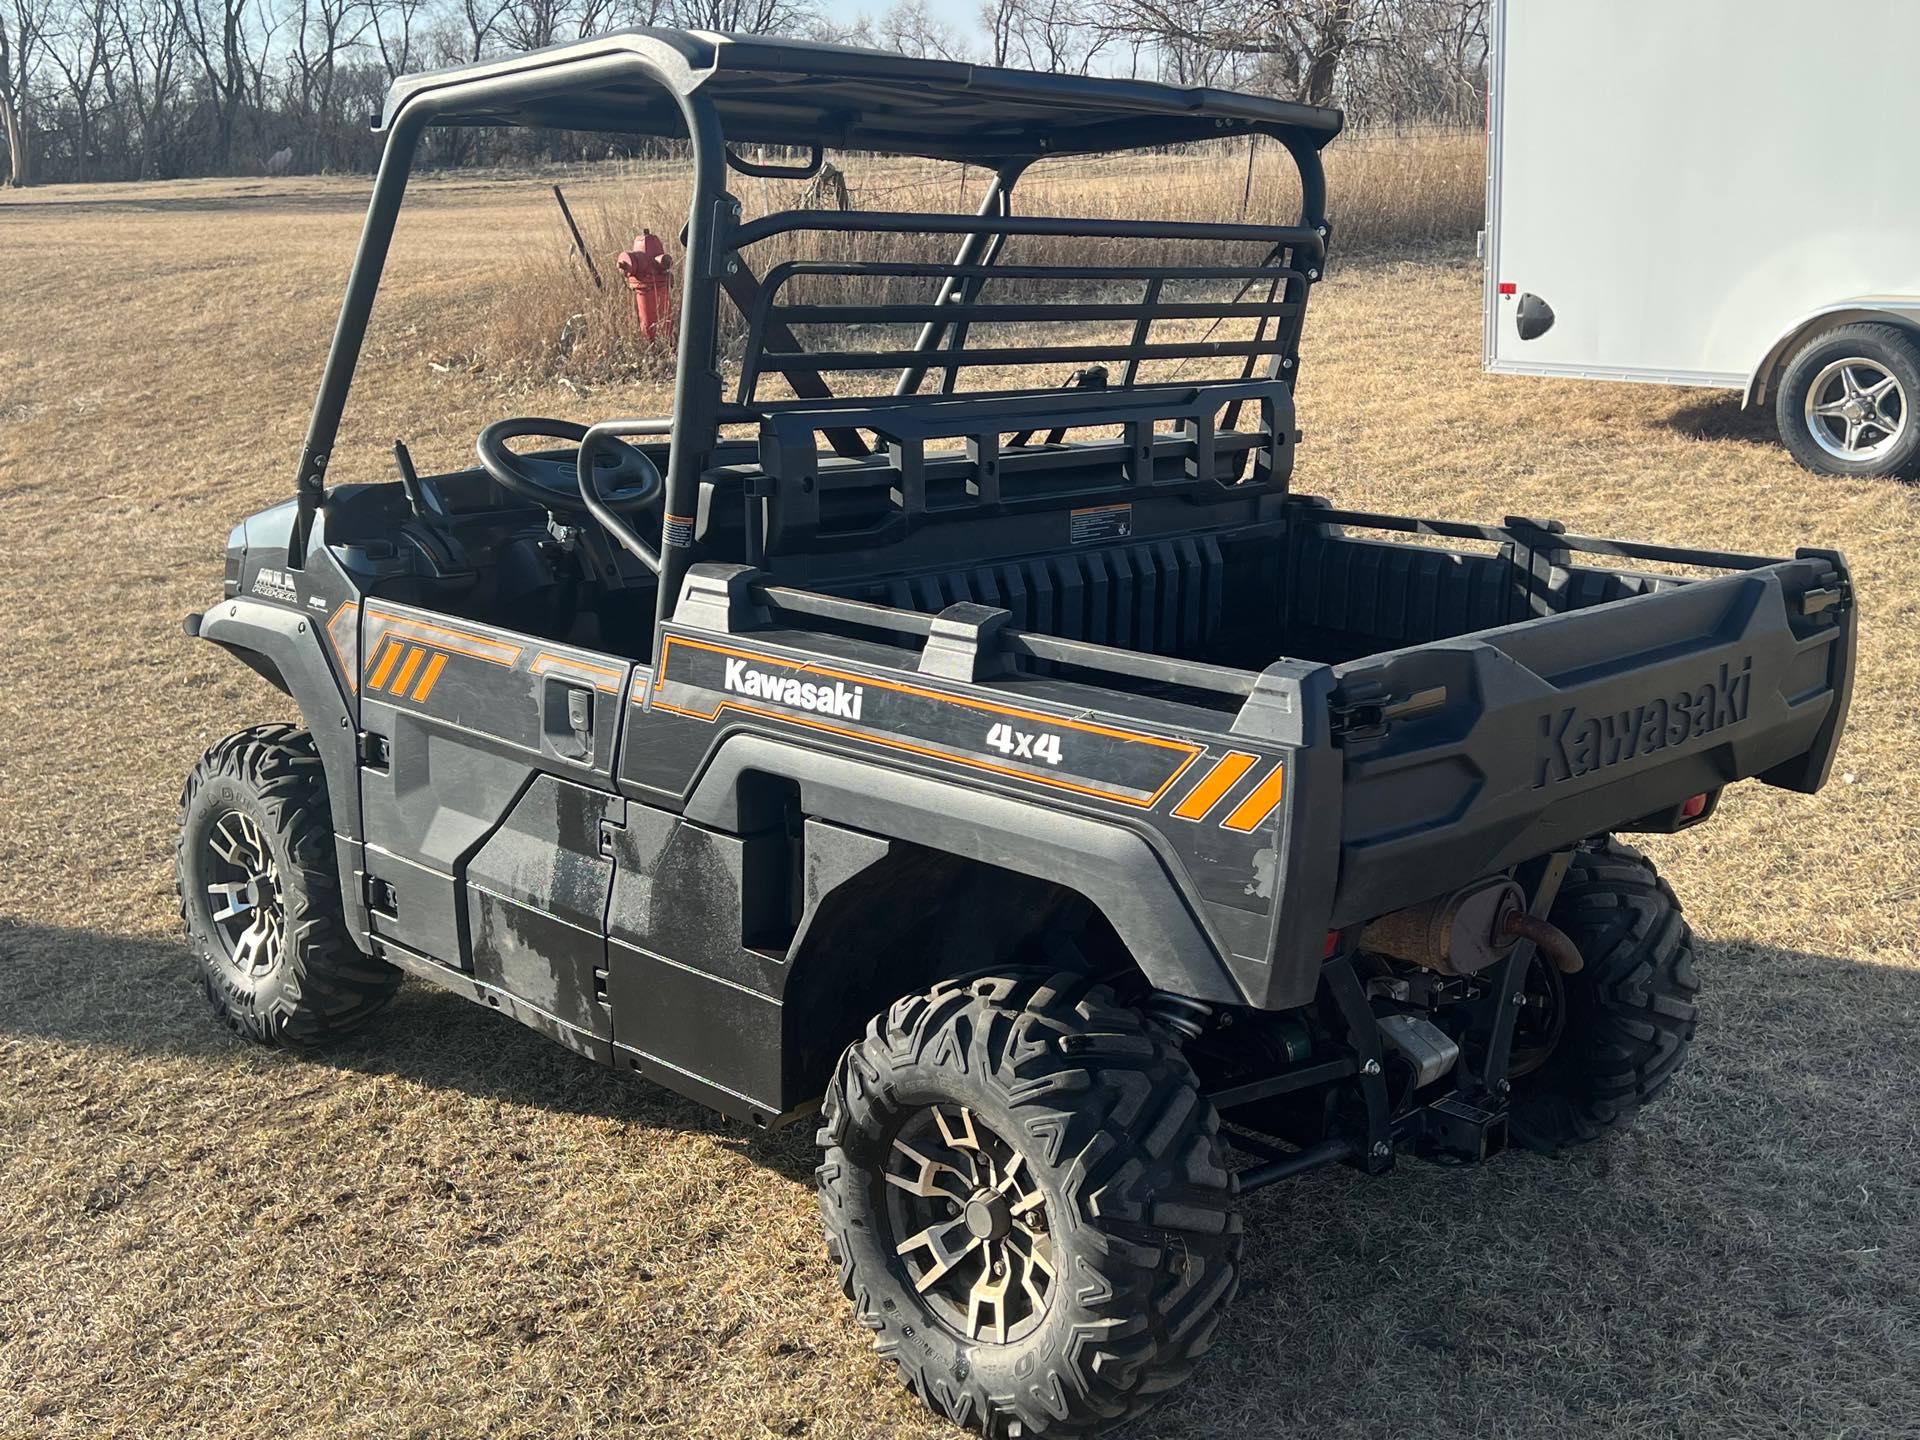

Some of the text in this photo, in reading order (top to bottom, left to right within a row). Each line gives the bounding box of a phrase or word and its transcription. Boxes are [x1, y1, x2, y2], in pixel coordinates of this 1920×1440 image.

[724, 657, 864, 721] Kawasaki
[986, 722, 1063, 765] 4x4
[1531, 655, 1752, 790] Kawasaki
